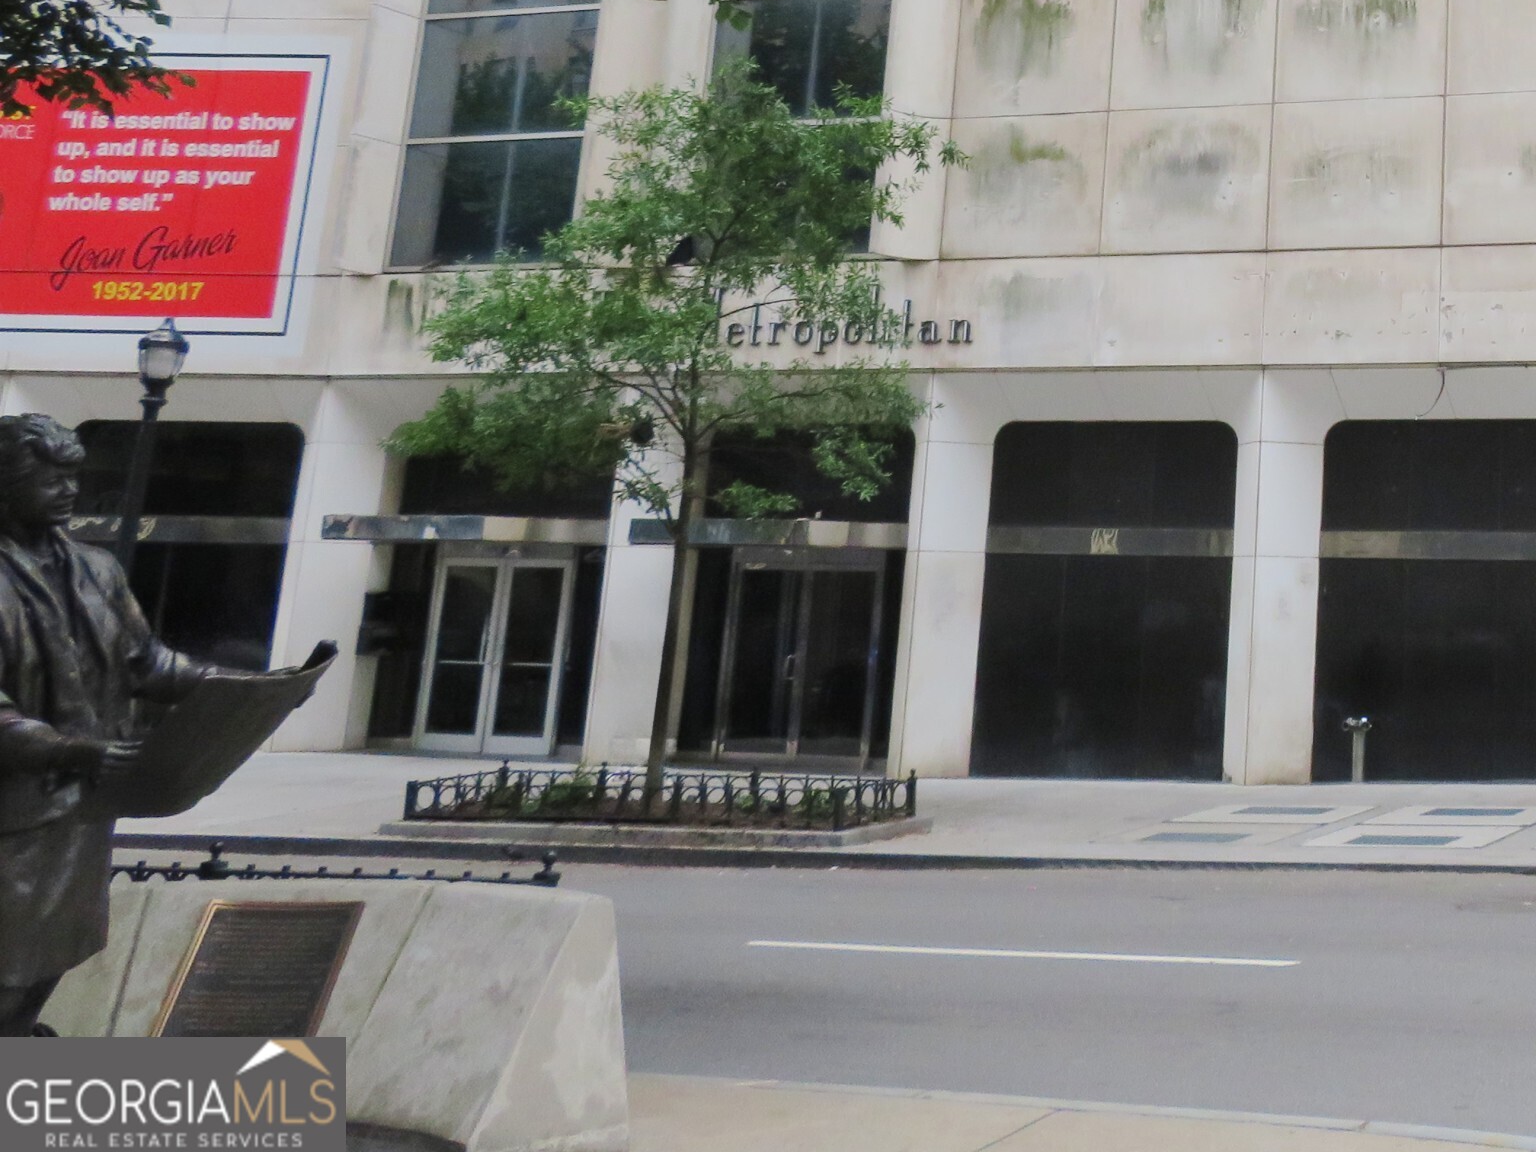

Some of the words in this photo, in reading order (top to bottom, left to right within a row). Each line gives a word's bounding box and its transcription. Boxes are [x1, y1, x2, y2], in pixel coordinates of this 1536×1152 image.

[91, 111, 110, 129] is
[115, 112, 209, 130] essential
[212, 113, 234, 130] to
[238, 113, 297, 131] show
[58, 141, 91, 160] up,
[96, 138, 138, 157] and
[141, 138, 157, 157] it
[160, 138, 180, 157] is
[184, 139, 280, 158] essential
[54, 165, 76, 183] to
[79, 165, 139, 184] show
[143, 169, 170, 189] up
[175, 170, 201, 185] as
[203, 171, 256, 189] your
[49, 192, 113, 211] whole
[50, 235, 127, 291] Joan
[132, 225, 237, 273] Garner
[92, 281, 205, 301] 1952-2017
[712, 283, 972, 355] etropolitan
